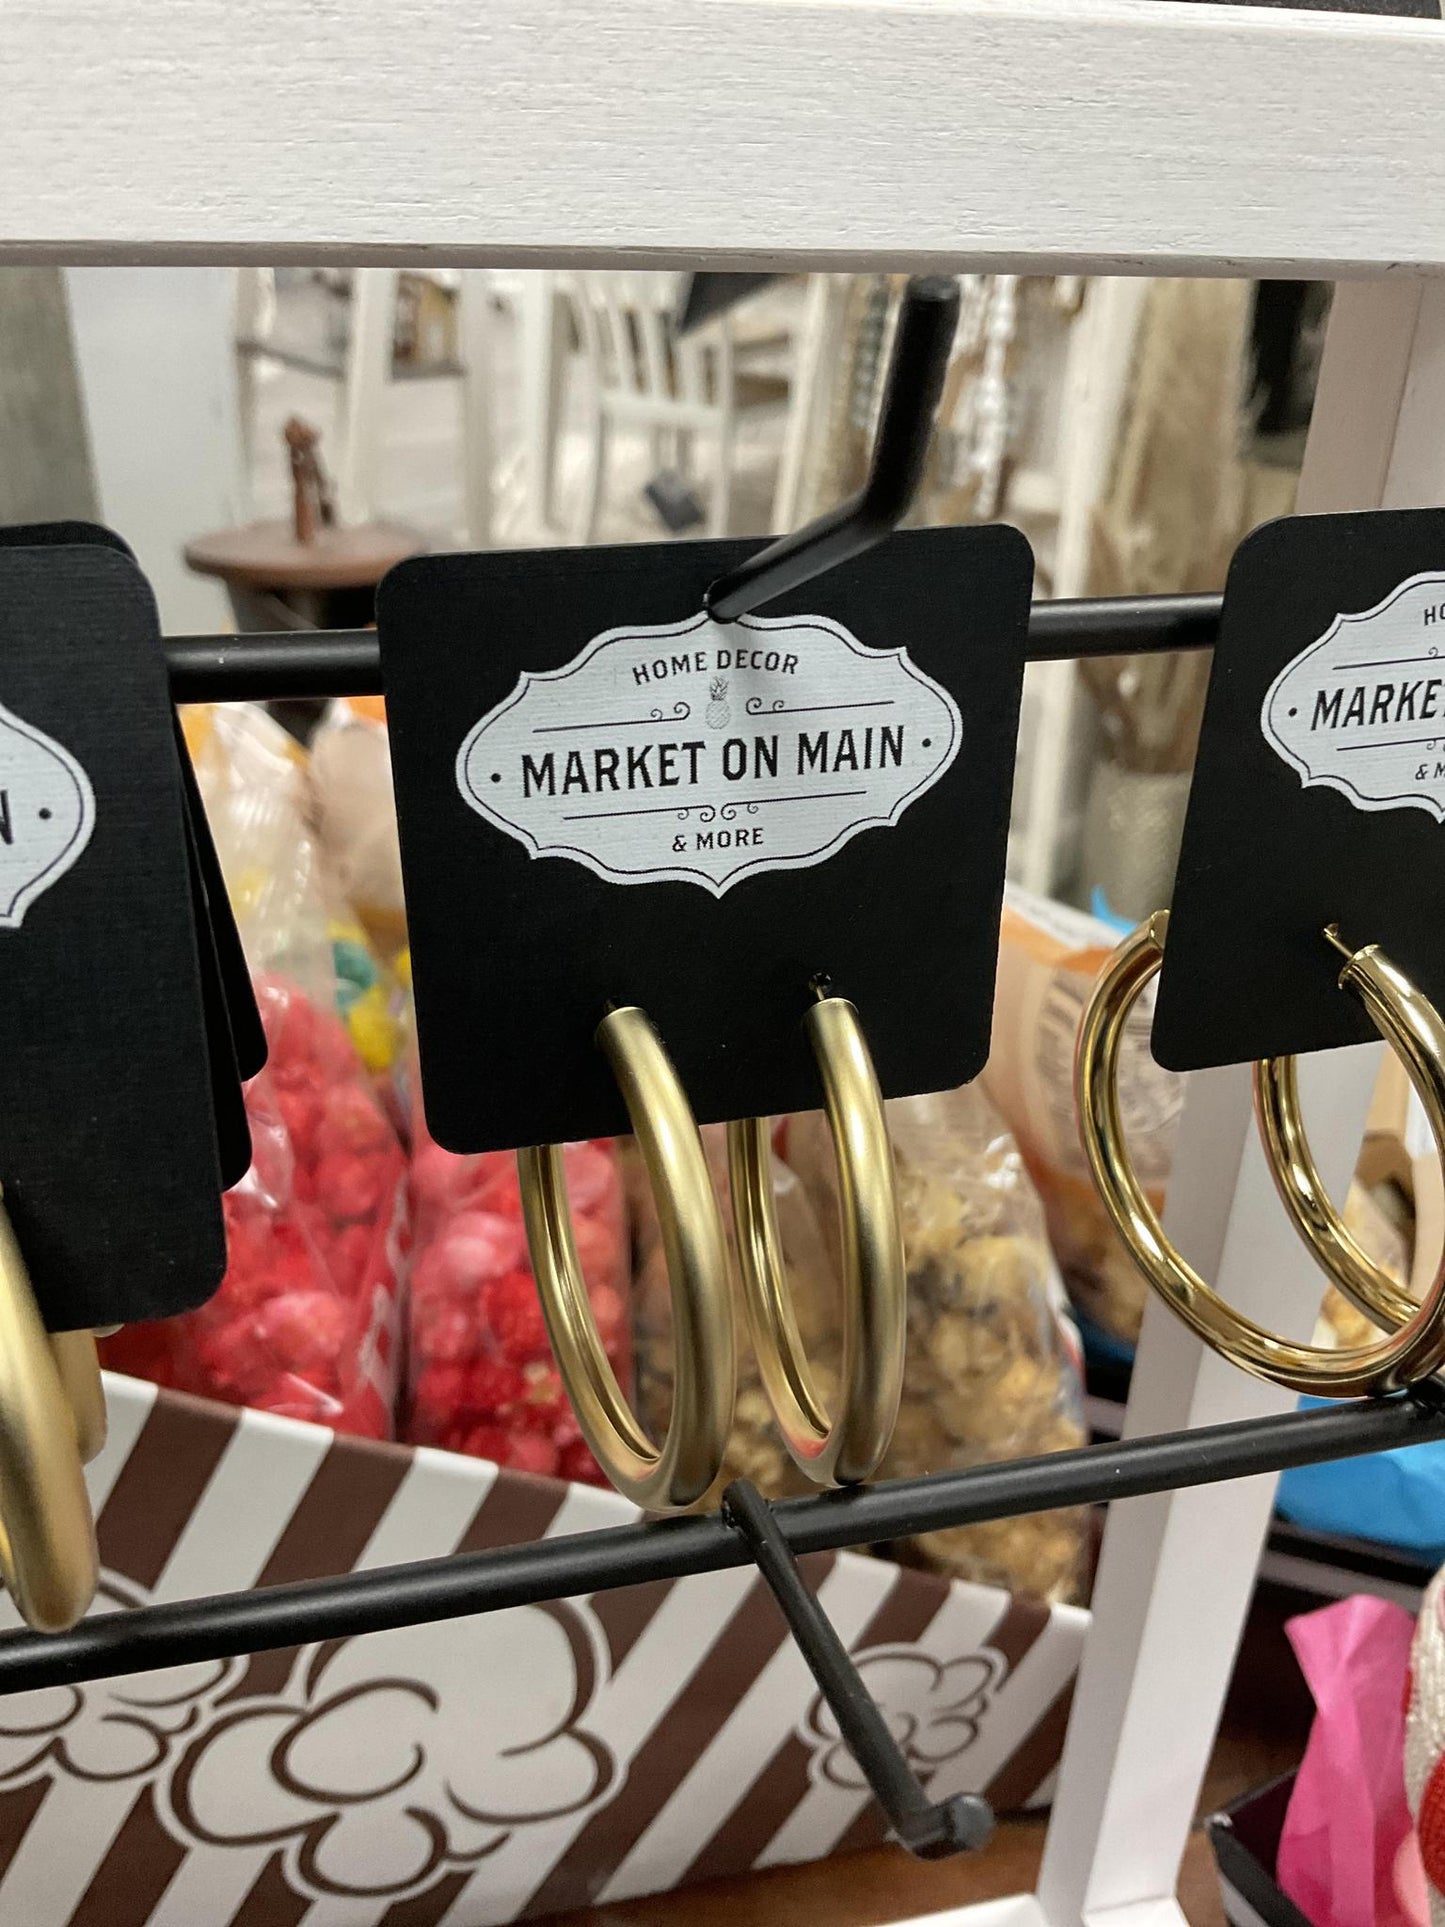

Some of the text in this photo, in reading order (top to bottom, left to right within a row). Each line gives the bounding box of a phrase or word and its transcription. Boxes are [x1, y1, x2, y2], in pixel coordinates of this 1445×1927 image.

[632, 649, 799, 685] HOME DECOR
[1310, 679, 1445, 731] MARKE
[522, 725, 905, 798] MARKET ON MAIN
[1415, 764, 1429, 780] &
[672, 828, 764, 853] & MORE
